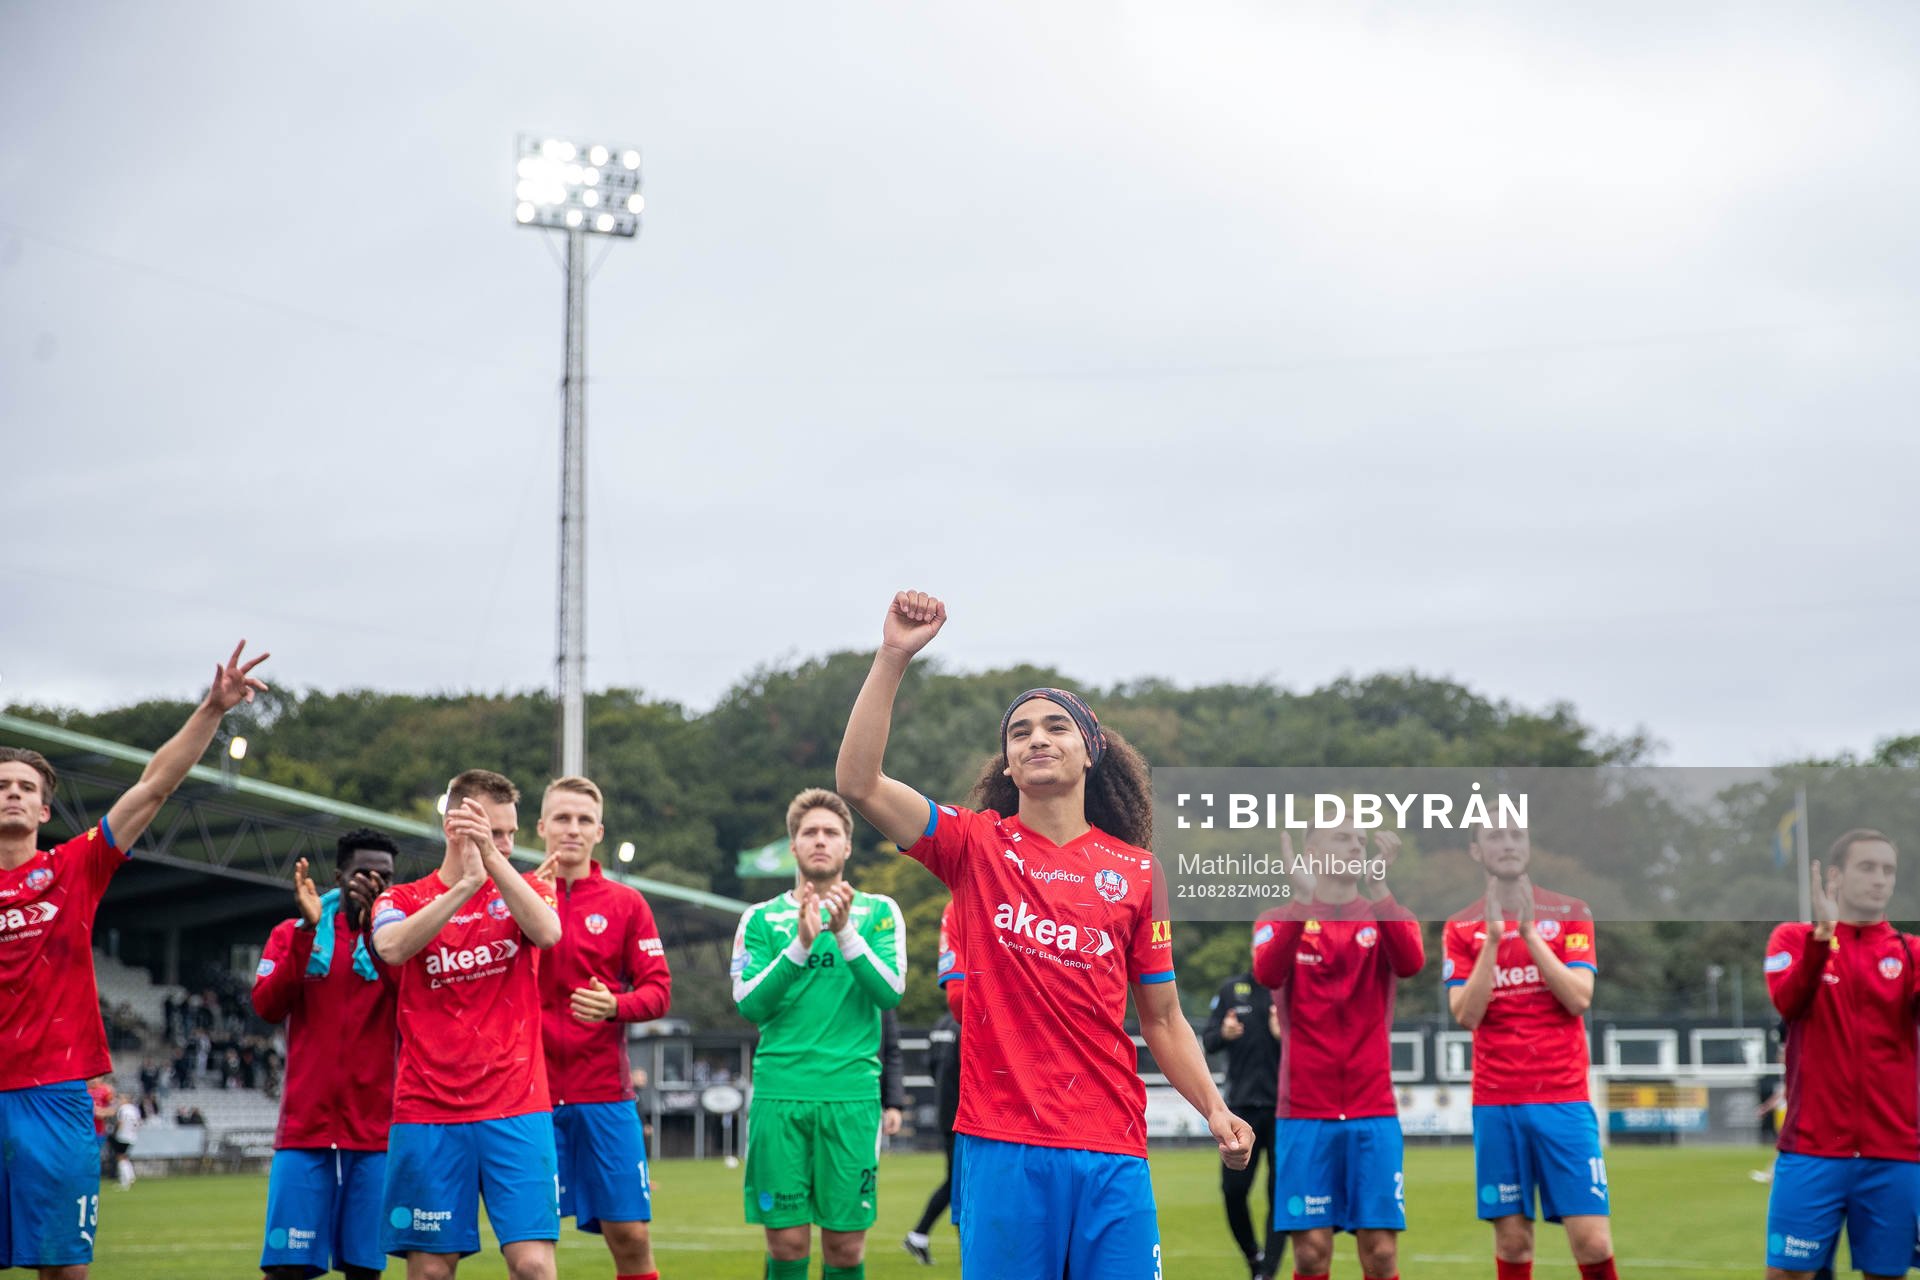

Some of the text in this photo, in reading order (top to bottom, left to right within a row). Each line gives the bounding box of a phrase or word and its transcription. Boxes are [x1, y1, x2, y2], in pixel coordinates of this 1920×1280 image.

[1031, 869, 1085, 884] kondektor
[994, 902, 1078, 951] akea
[426, 945, 493, 975] akea
[802, 951, 835, 970] ea
[1026, 947, 1037, 955] OF
[1064, 959, 1092, 971] GROUP
[1494, 964, 1540, 988] kea
[76, 1194, 98, 1227] 13
[413, 1208, 452, 1221] Resurs
[413, 1220, 441, 1232] Bank
